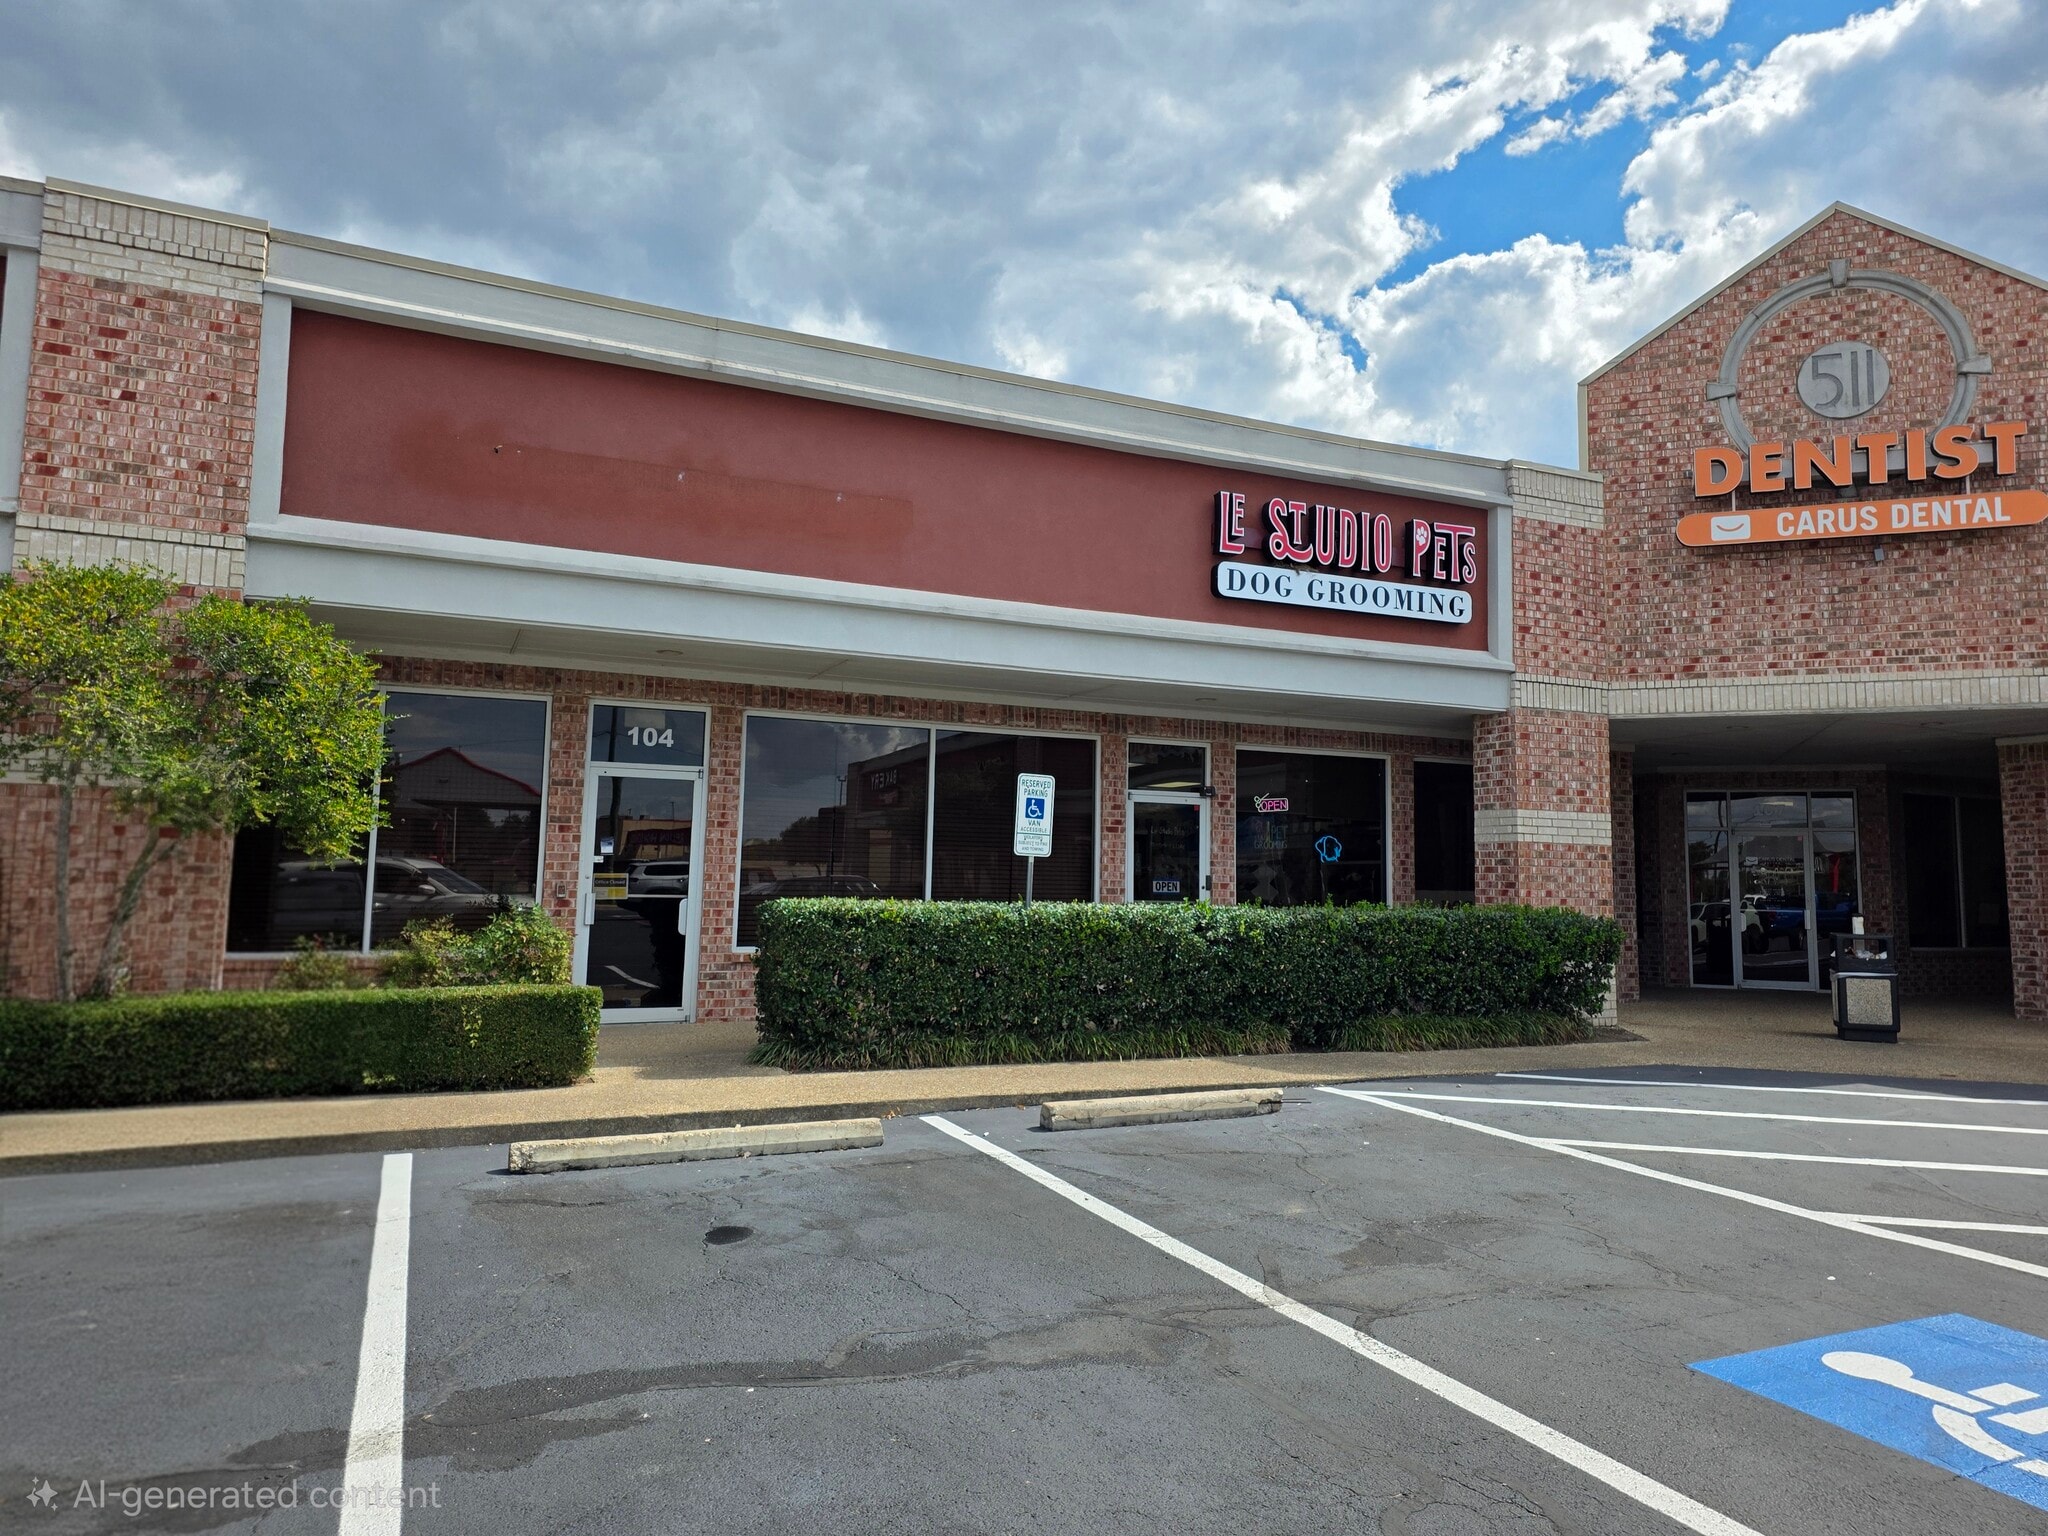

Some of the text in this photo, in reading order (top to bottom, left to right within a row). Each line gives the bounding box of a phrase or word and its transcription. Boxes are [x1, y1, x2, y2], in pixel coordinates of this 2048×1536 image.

[1811, 349, 1875, 410] 511
[1693, 421, 2029, 497] DENTIST
[1777, 496, 2011, 537] CARUS DENTAL
[1216, 490, 1478, 584] LE STUDIO PETS
[1226, 568, 1466, 617] DOG GROOMING
[627, 726, 675, 748] 104
[1021, 779, 1051, 789] RESERVED
[1023, 788, 1048, 798] PARKING
[1261, 800, 1288, 811] OPEN
[1028, 819, 1041, 827] VAN
[1155, 881, 1178, 892] OPEN
